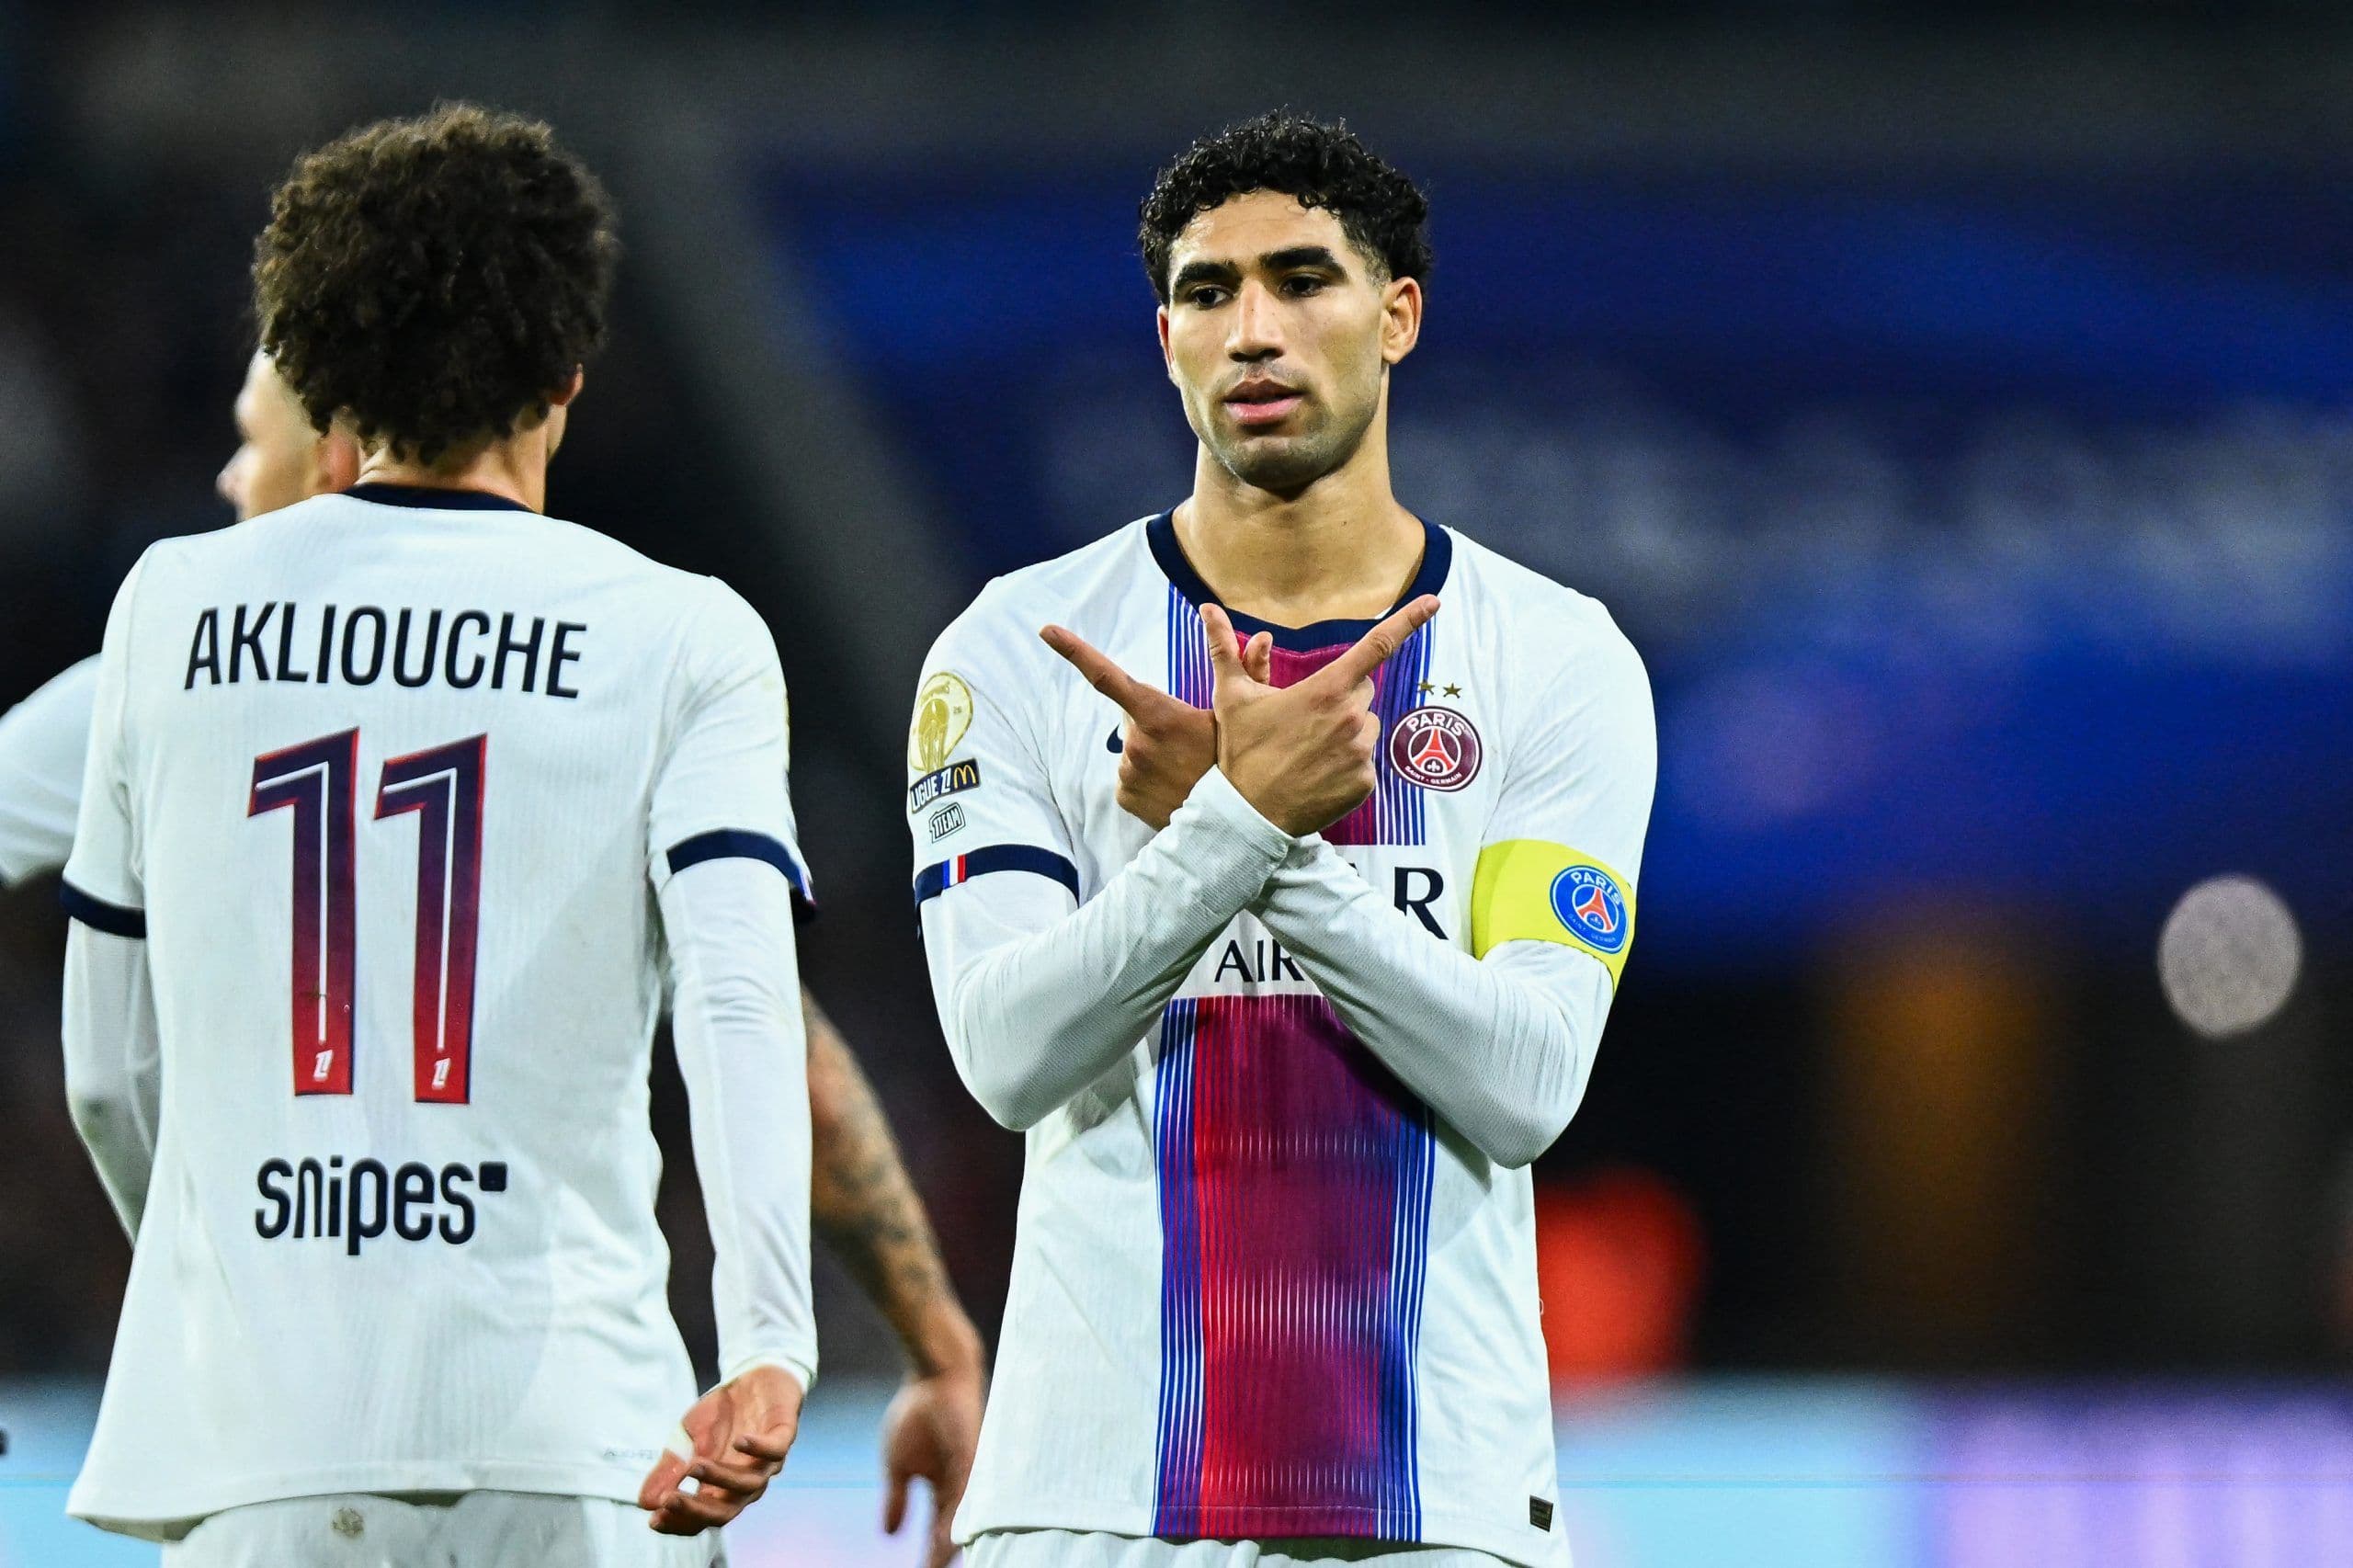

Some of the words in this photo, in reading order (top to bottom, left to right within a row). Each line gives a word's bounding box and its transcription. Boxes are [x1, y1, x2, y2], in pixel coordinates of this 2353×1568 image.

[184, 601, 587, 699] AKLIOUCHE
[1405, 712, 1466, 736] PARIS
[911, 775, 939, 812] LIGUE
[247, 726, 488, 1106] 11
[1570, 871, 1623, 905] PARIS
[255, 1154, 476, 1256] snipes
